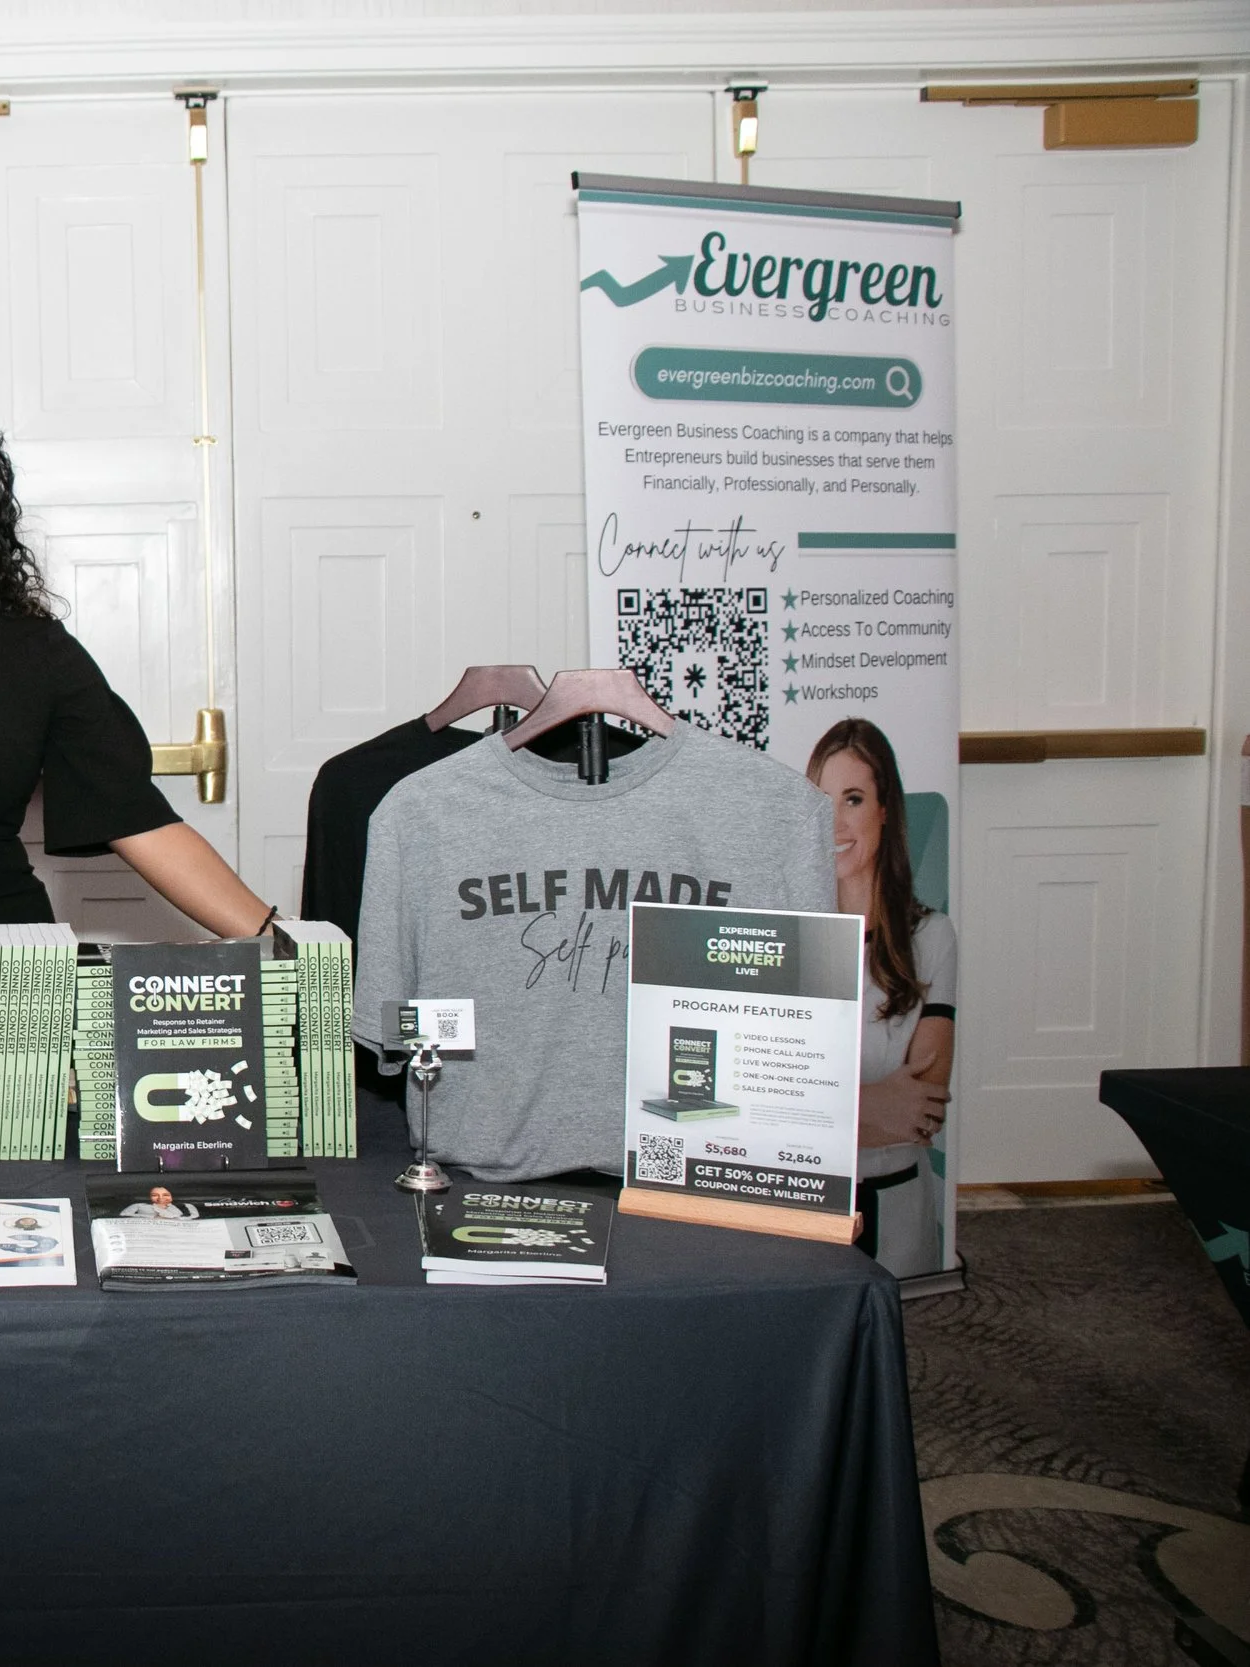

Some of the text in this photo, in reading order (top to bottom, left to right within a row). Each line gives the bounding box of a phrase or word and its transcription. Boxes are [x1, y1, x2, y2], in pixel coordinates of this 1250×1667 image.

[693, 231, 943, 322] Evergreen
[675, 298, 951, 327] BUSINESS COACHING
[657, 366, 875, 393] evergreenbizcoaching.com
[598, 422, 954, 447] Evergreen Business Coaching is a company that helps
[625, 448, 935, 469] Entrepreneurs build businesses that serve them
[644, 475, 920, 497] Financially, Professionally, and Personally.
[598, 512, 785, 583] Connect with us
[801, 589, 954, 608] Personalized Coaching
[801, 620, 951, 639] Access To Community
[801, 651, 948, 669] Mindset Development
[801, 684, 878, 701] Workshops
[458, 868, 732, 920] SELF MADE
[719, 926, 777, 937] EXPERIENCE
[521, 911, 593, 991] Self
[707, 938, 785, 955] CONNECT
[707, 952, 784, 967] CONVERT
[735, 967, 759, 976] LIVE!
[129, 975, 246, 994] CONNECT
[62, 958, 75, 1053] CONNECT CONVERT
[130, 993, 245, 1012] CONVERT
[673, 999, 812, 1020] PROGRAM FEATURES
[137, 1028, 172, 1036] Marketing
[153, 1019, 186, 1027] Response
[201, 1038, 236, 1046] FIRMS
[743, 1033, 806, 1045] VIDEO LESSONS
[744, 1046, 771, 1054] PHONE
[795, 1051, 825, 1060] AUDITS
[762, 1061, 810, 1071] WORKSHOP
[743, 1072, 839, 1087] ONE-ON-ONE COACHING
[742, 1085, 805, 1097] SALES PROCESS
[153, 1140, 233, 1151] Margarita Eberline
[705, 1142, 821, 1165] $5,680 $2,840
[695, 1164, 825, 1190] GET 50% OFF NOW
[695, 1179, 825, 1203] COUPON CODE: WILBETTY
[463, 1200, 590, 1213] CONVERT
[464, 1194, 593, 1208] CONNECT
